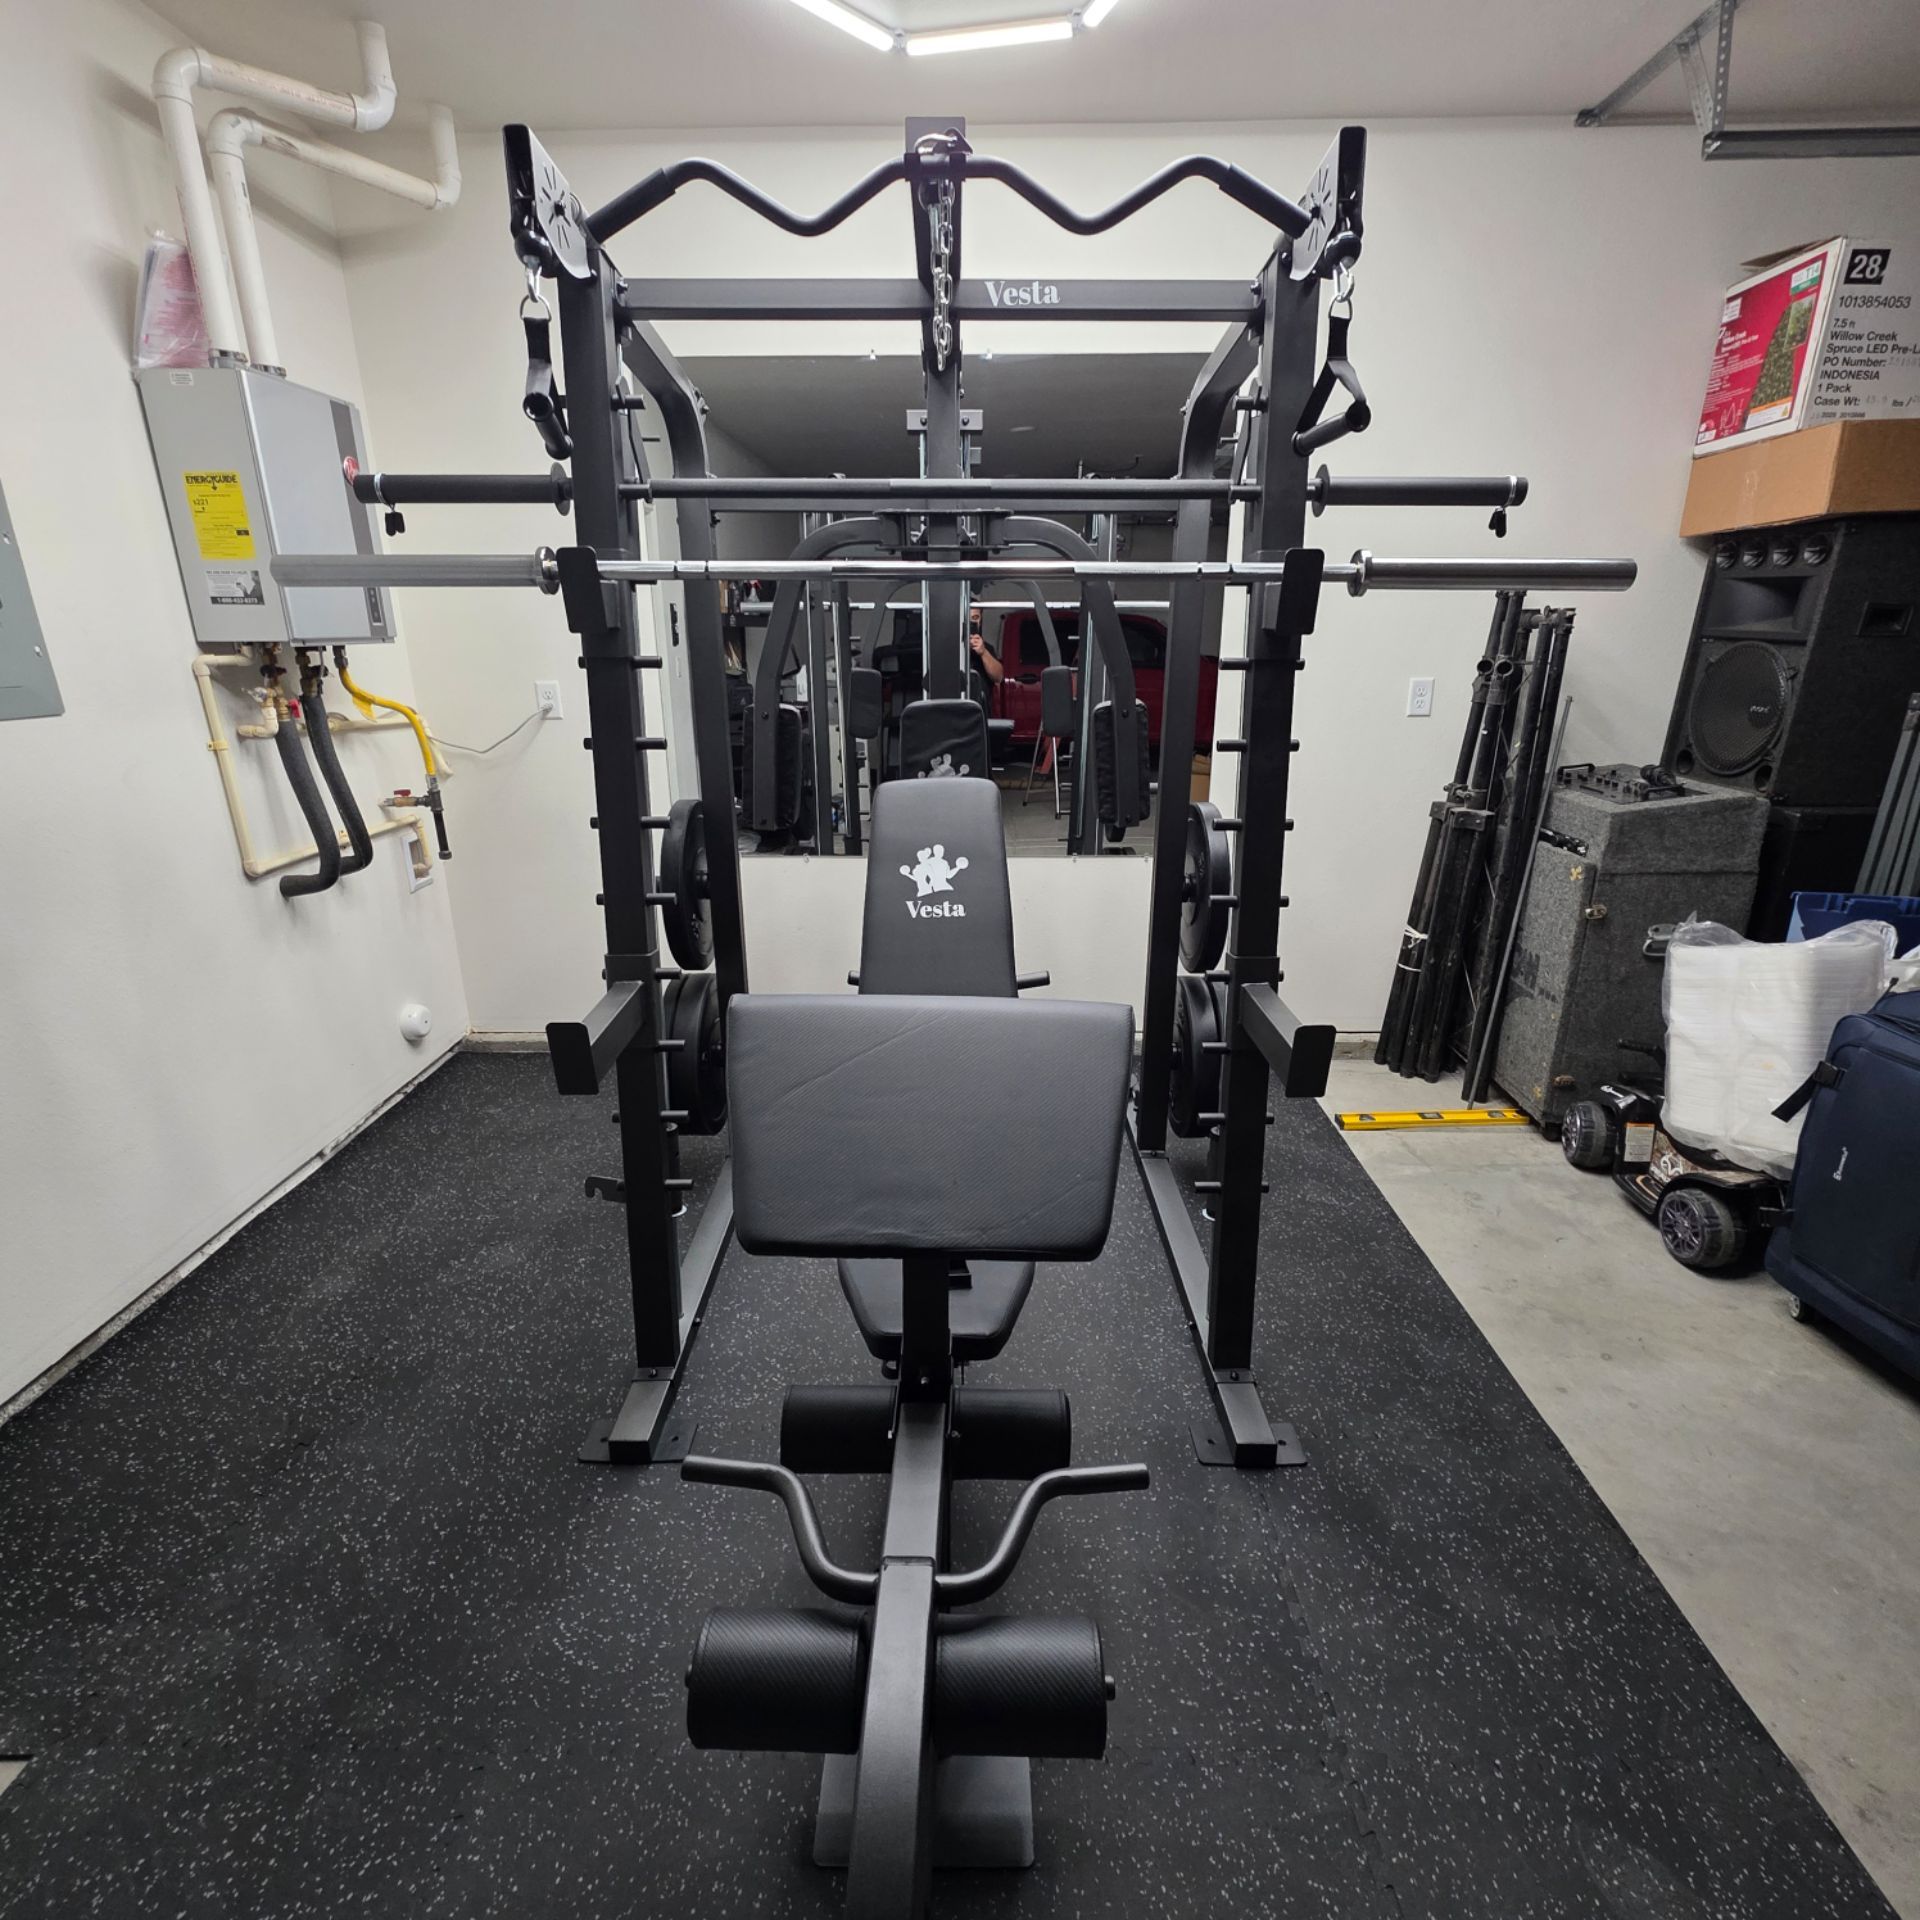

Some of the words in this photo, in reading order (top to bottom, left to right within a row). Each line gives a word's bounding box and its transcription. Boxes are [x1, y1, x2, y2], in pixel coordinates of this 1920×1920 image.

[1849, 254, 1882, 279] 28
[984, 280, 1060, 307] Vesta
[1839, 295, 1912, 309] 1013854053
[1833, 317, 1848, 328] 7.5
[1830, 331, 1865, 341] Willow
[1866, 331, 1898, 341] Creek
[1826, 343, 1864, 355] Spruce
[1866, 343, 1888, 354] LED
[1823, 356, 1839, 367] PO
[1841, 357, 1887, 367] Number:
[1820, 369, 1880, 380] INDONESIA
[1825, 383, 1852, 393] Pack
[1814, 396, 1840, 406] Case
[1843, 396, 1860, 406] Wt:
[905, 900, 967, 919] Vesta
